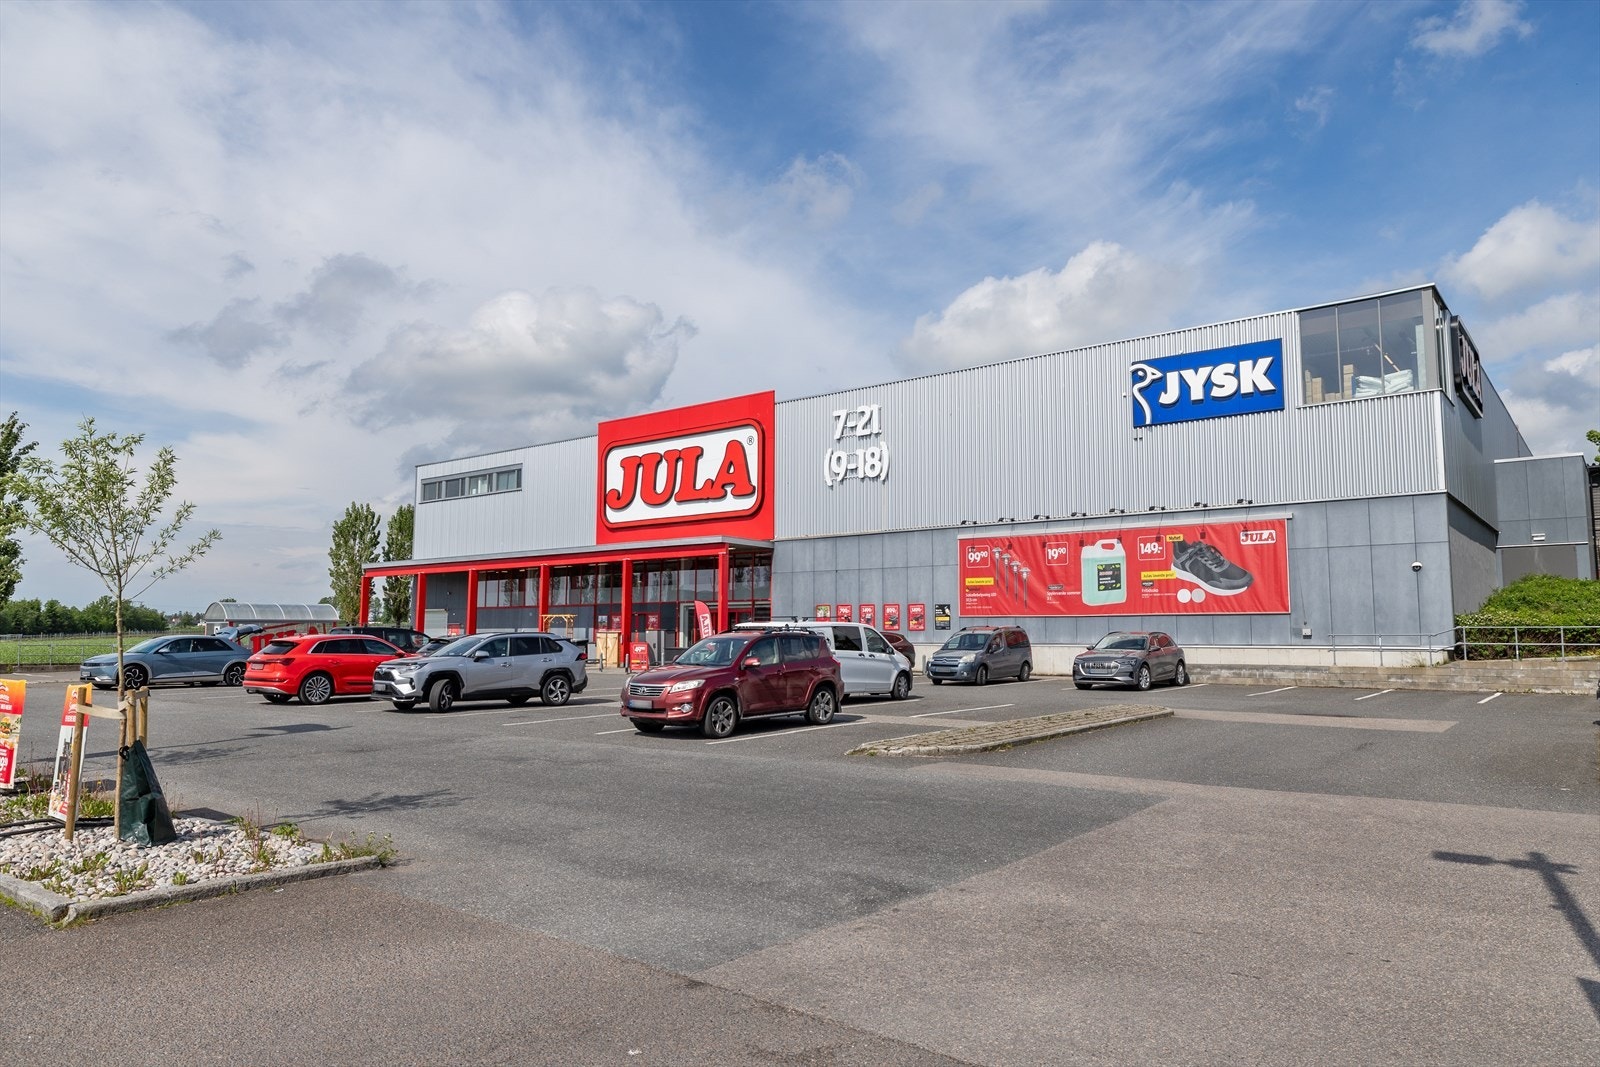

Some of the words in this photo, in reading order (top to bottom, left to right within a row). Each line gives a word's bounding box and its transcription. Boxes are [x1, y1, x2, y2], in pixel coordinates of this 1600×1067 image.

[1158, 356, 1276, 406] JYSK
[832, 404, 882, 440] 7-21
[605, 439, 756, 510] JULA
[823, 441, 890, 487] (9-18)
[1241, 531, 1276, 542] JULA
